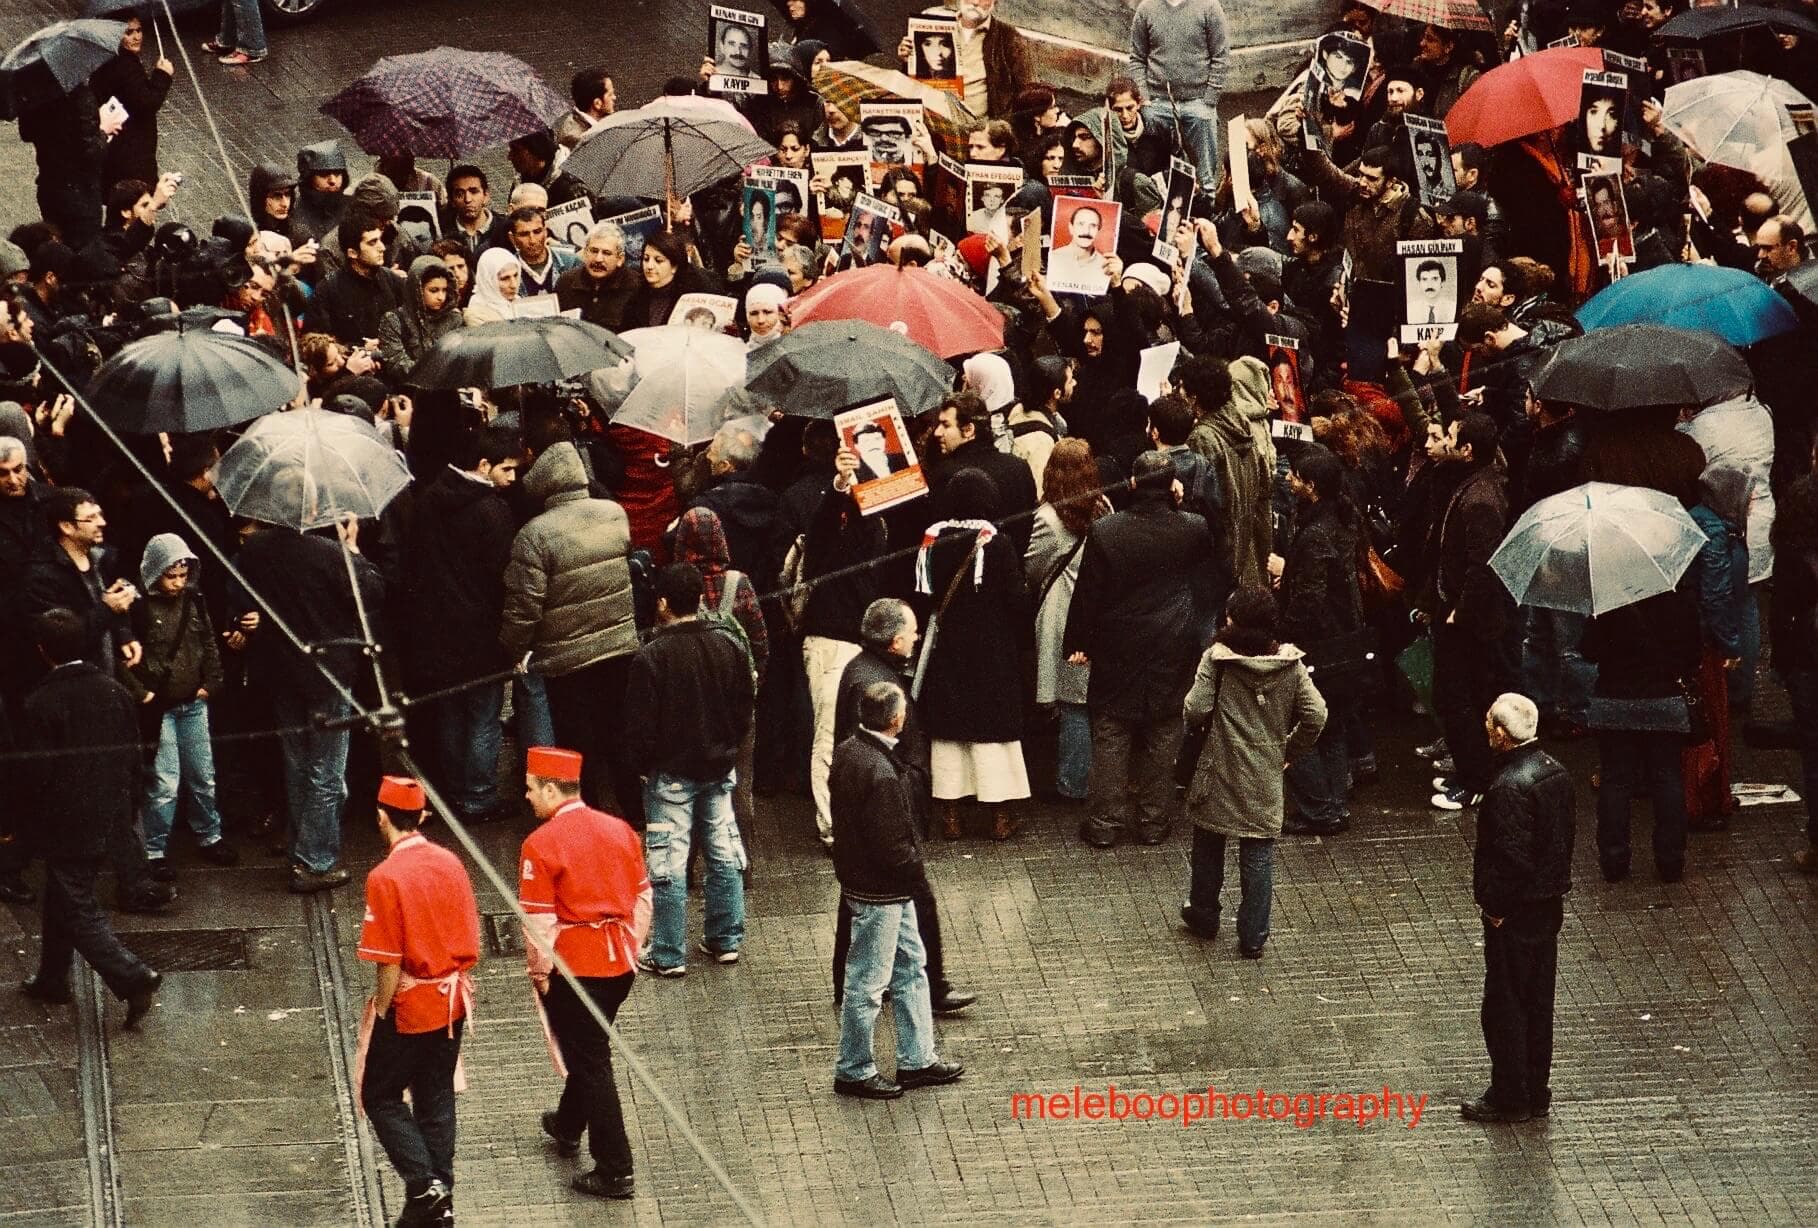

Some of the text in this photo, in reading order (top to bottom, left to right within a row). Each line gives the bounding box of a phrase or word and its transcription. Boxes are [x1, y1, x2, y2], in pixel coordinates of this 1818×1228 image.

[723, 77, 750, 91] KAYIP
[1401, 243, 1426, 255] HASAN
[708, 298, 733, 309] OCAK
[1283, 424, 1303, 440] KAYIP
